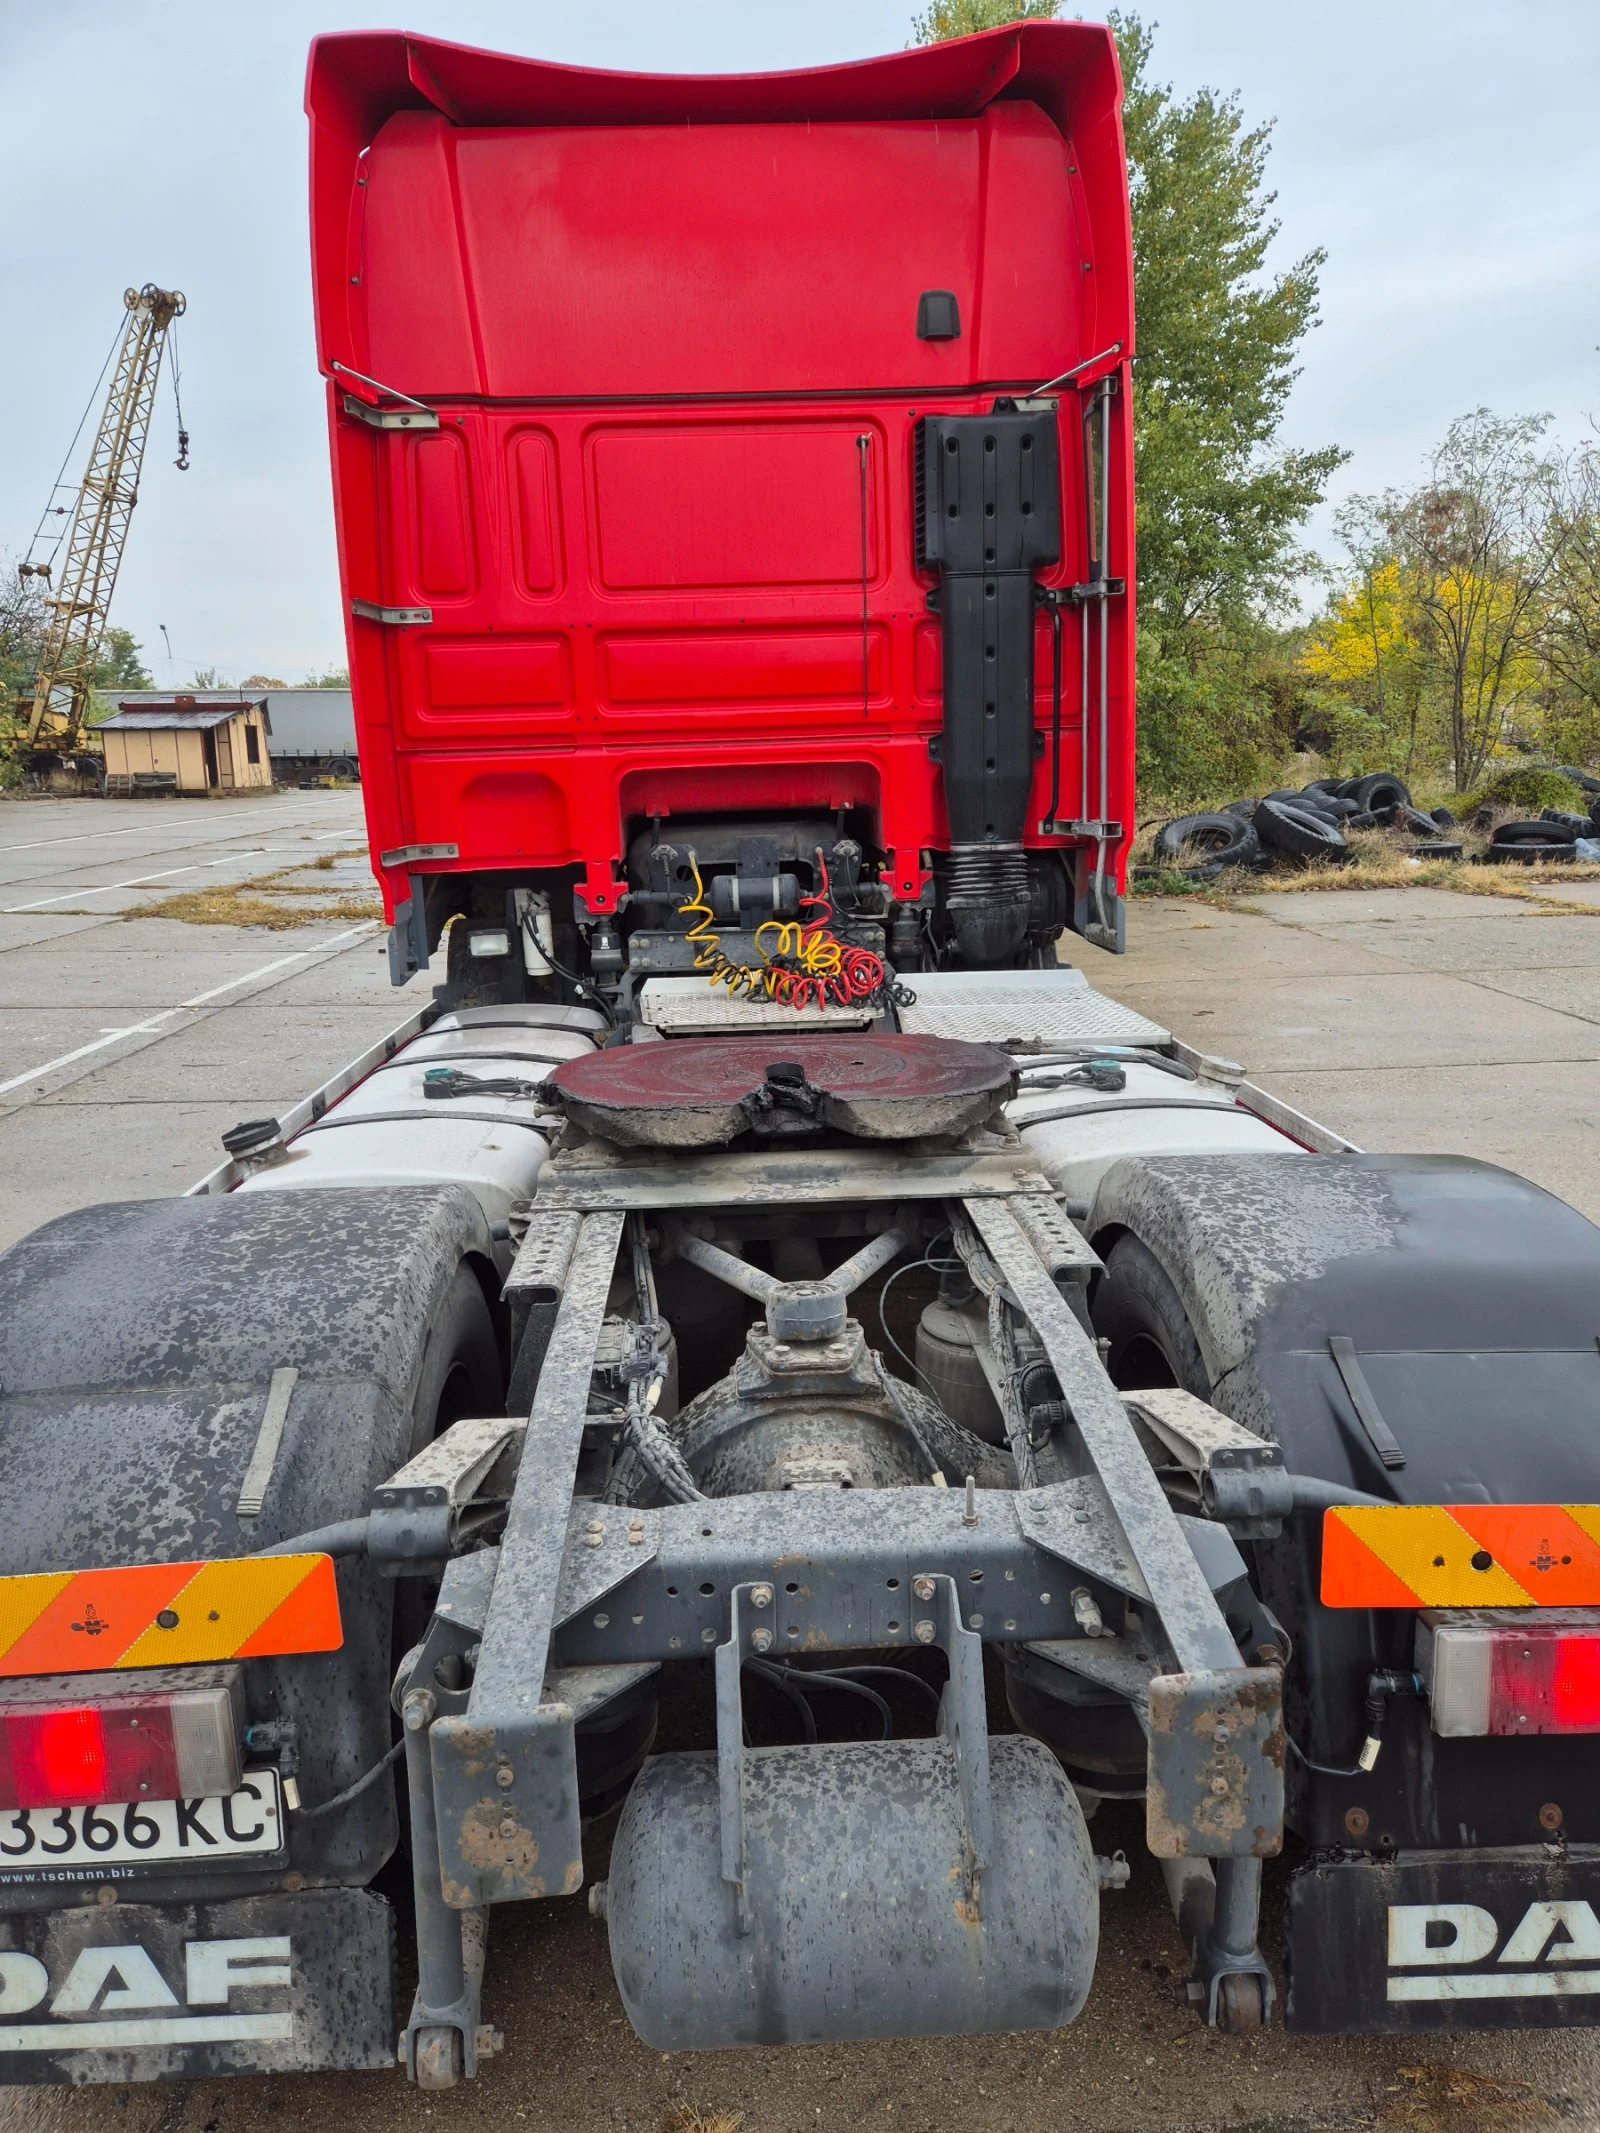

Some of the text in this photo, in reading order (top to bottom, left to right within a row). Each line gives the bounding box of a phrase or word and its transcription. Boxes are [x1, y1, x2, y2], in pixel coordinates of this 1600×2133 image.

[0, 1783, 264, 1855] 3366 KC
[0, 1868, 135, 1882] www.tschann.biz
